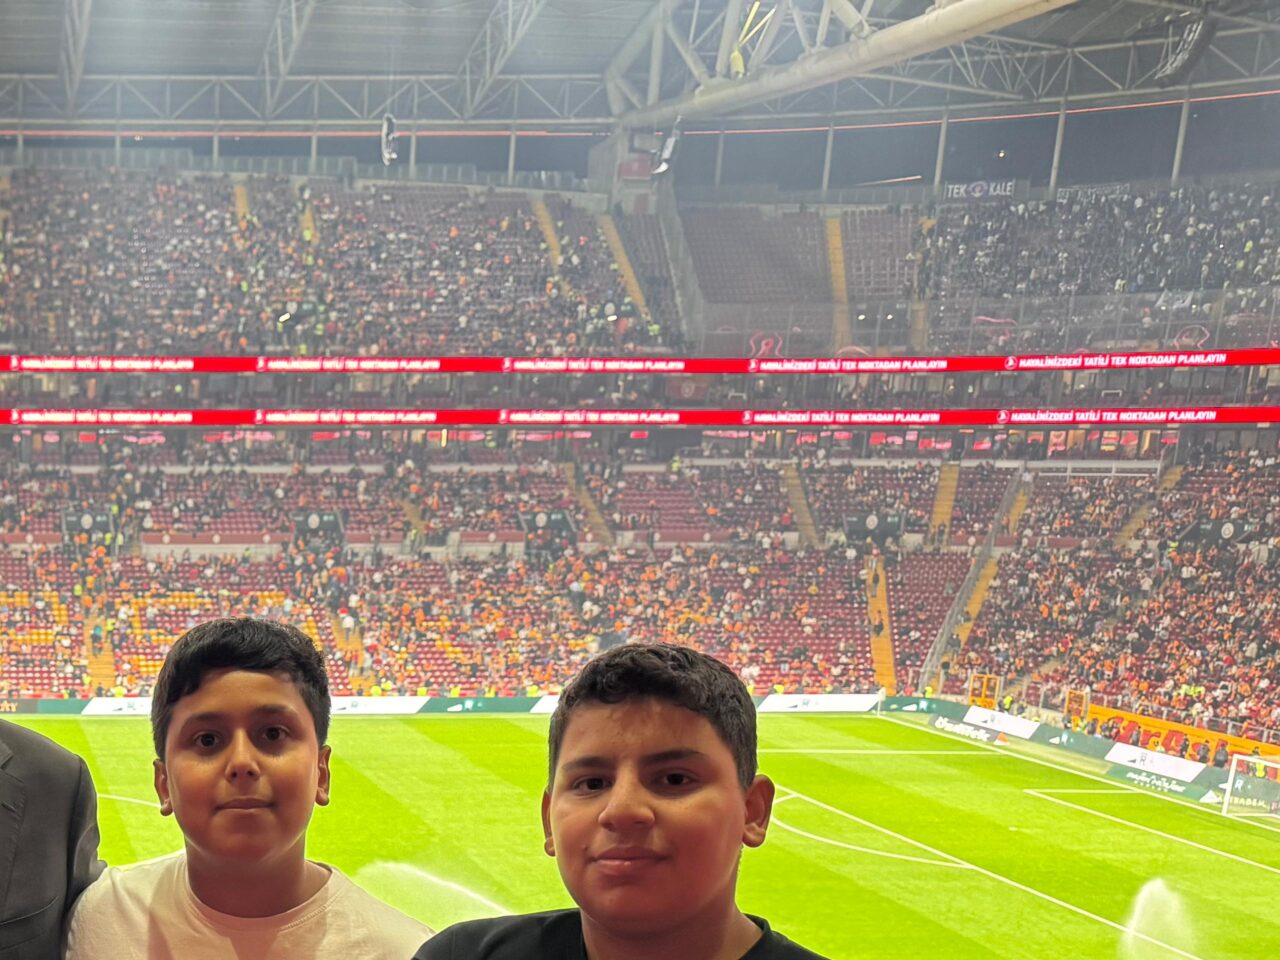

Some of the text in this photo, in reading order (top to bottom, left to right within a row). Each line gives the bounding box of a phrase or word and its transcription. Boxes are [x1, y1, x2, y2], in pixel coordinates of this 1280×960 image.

[947, 181, 1013, 198] TEK KALE
[1084, 354, 1110, 366] TATİLİ
[1111, 356, 1127, 366] TEK
[1128, 354, 1177, 365] NOKTADAN
[1178, 353, 1226, 364] PLANLAYIN
[1075, 409, 1100, 421] TATİLİ
[1102, 411, 1118, 420] TEK
[1119, 411, 1167, 420] NOKTADAN
[1168, 410, 1216, 420] PLANLAYIN
